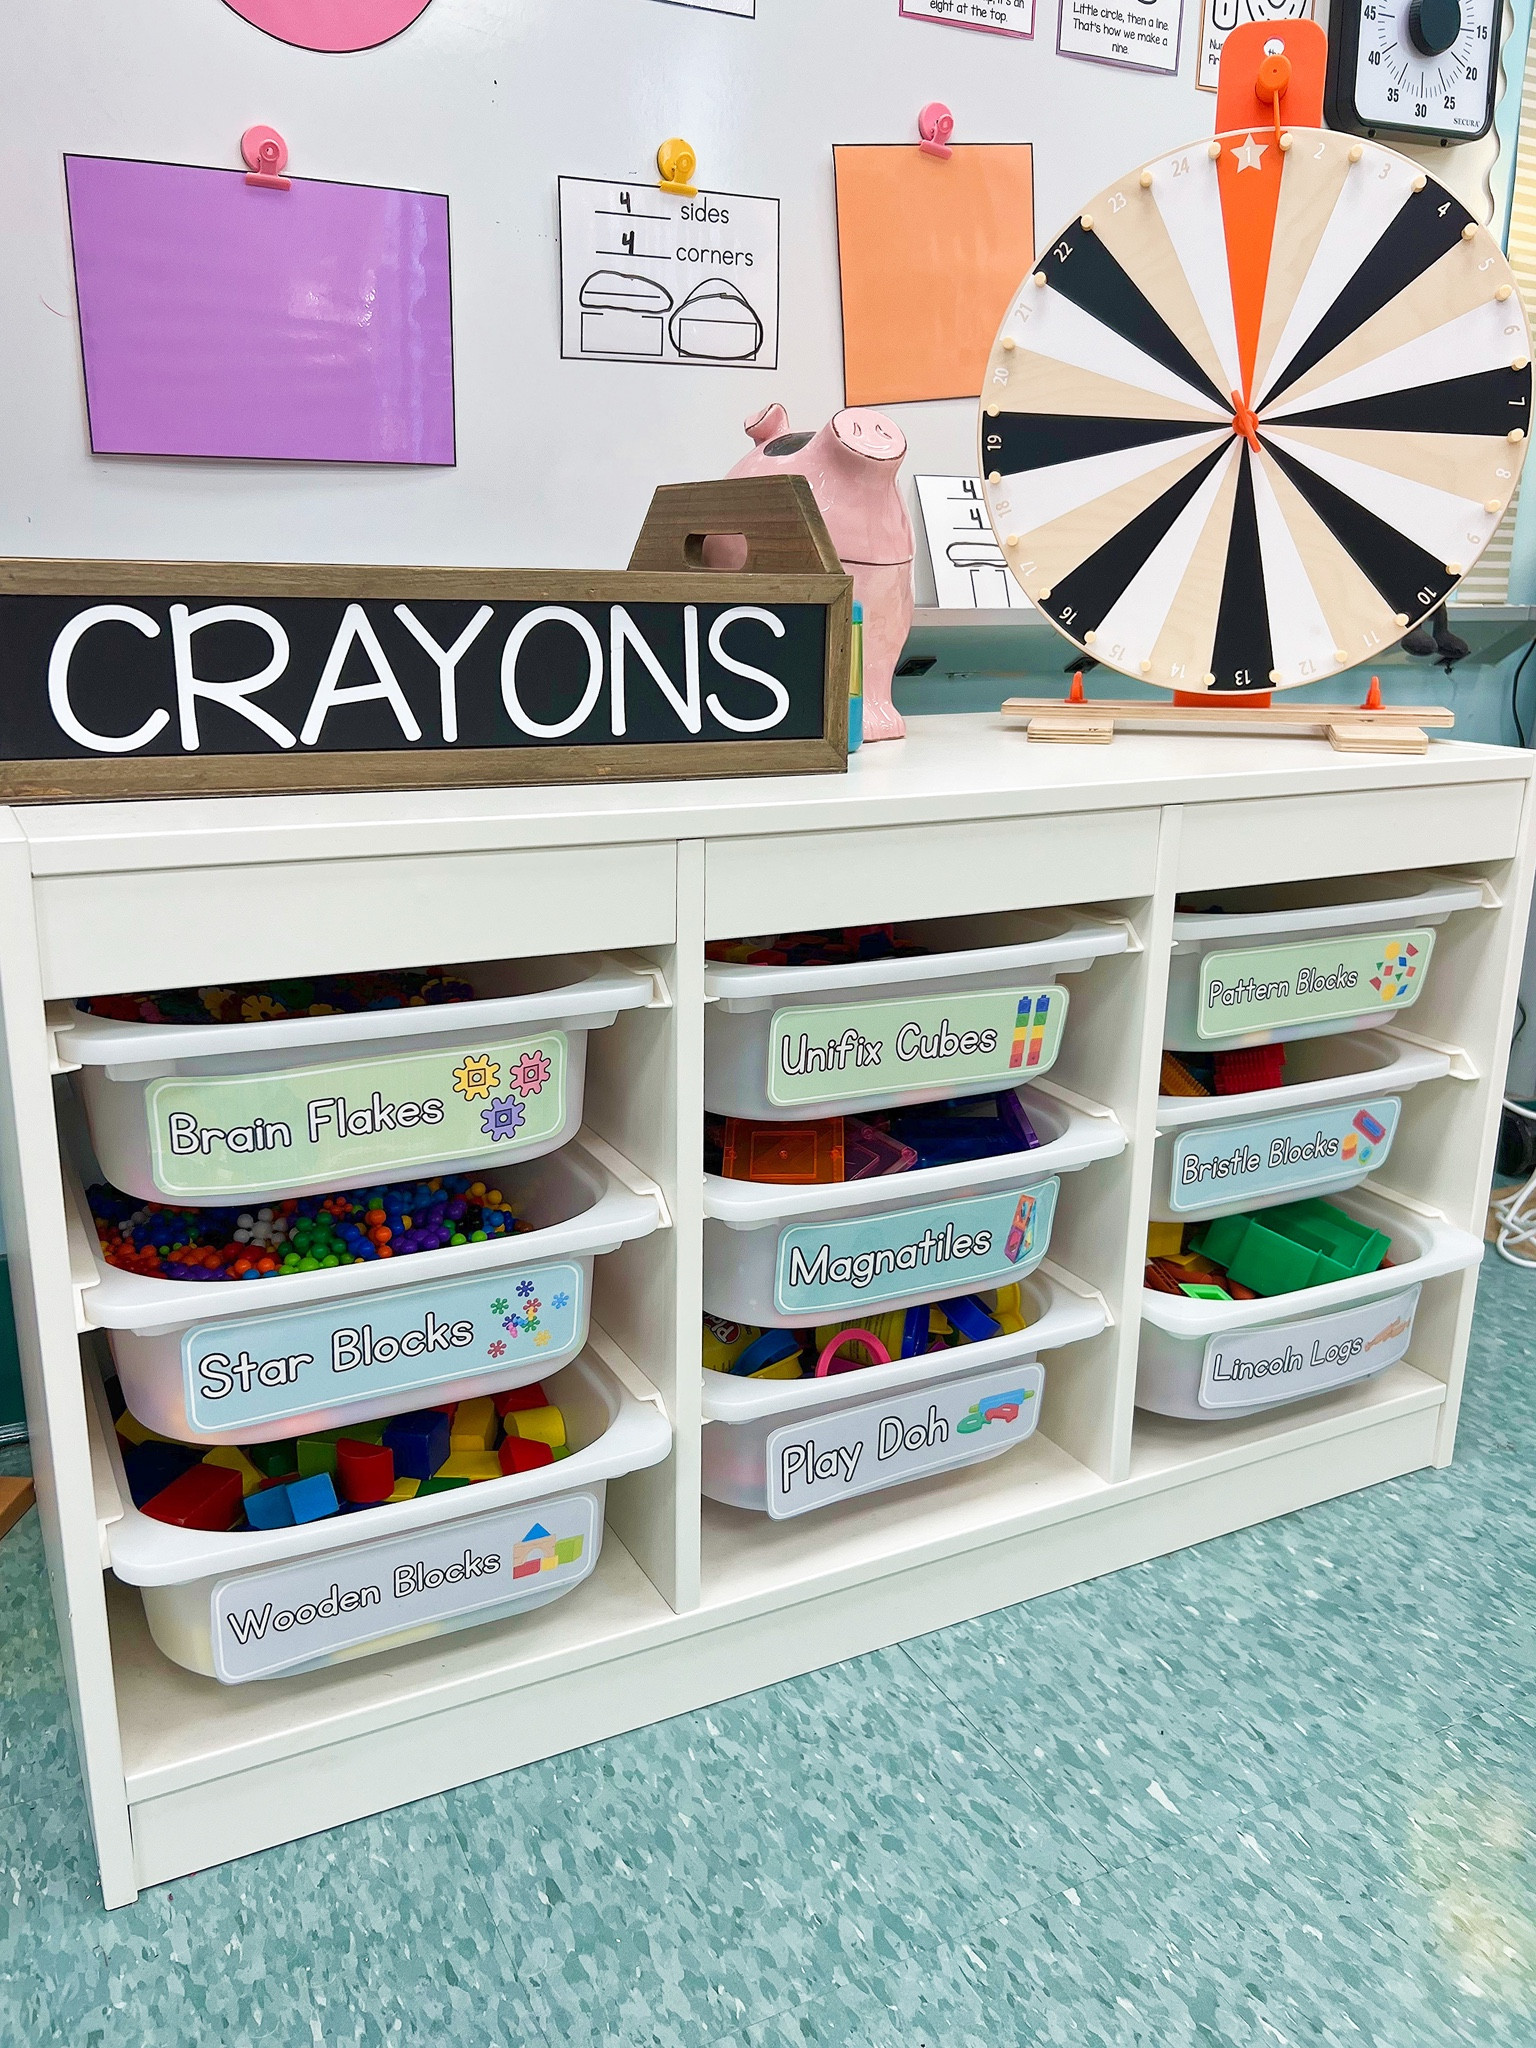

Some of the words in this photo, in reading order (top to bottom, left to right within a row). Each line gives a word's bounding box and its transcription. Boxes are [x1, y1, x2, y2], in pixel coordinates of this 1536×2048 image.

[930, 0, 954, 13] eight
[957, 3, 968, 14] at
[971, 4, 987, 18] the
[989, 8, 1008, 24] top.
[1073, 2, 1098, 16] Little
[1100, 8, 1124, 23] circle,
[1127, 12, 1147, 26] then
[1148, 19, 1154, 28] a
[1155, 18, 1170, 31] line.
[1364, 5, 1376, 20] 45
[1073, 18, 1101, 33] That's
[1103, 24, 1122, 37] how
[1124, 31, 1136, 40] we
[1137, 33, 1160, 45] make
[1162, 37, 1168, 46] a
[1477, 25, 1488, 40] 15
[1112, 42, 1130, 55] nine.
[1368, 50, 1381, 66] 40
[1466, 66, 1478, 81] 20
[1387, 87, 1399, 103] 35
[1444, 95, 1456, 110] 25
[1414, 103, 1427, 118] 30
[1453, 118, 1479, 128] SECURA
[1313, 143, 1326, 160] 2
[1171, 157, 1190, 177] 24
[1378, 162, 1391, 180] 3
[620, 191, 632, 213] 4
[680, 196, 730, 224] sides
[1107, 191, 1127, 214] 23
[1437, 201, 1452, 218] 4
[621, 230, 635, 255] 4
[676, 246, 754, 266] corners
[1053, 241, 1073, 263] 22
[1478, 257, 1495, 271] 5
[1014, 302, 1033, 323] 21
[993, 367, 1009, 386] 20
[1508, 396, 1526, 406] 7
[986, 434, 1002, 451] 19
[1495, 468, 1511, 480] 8
[962, 480, 977, 499] 4
[969, 508, 983, 529] 4
[995, 500, 1012, 518] 18
[1019, 560, 1037, 577] 17
[1417, 584, 1437, 605] 10
[1059, 605, 1079, 625] 16
[1362, 630, 1380, 647] 11
[1108, 643, 1126, 661] 15
[1170, 662, 1186, 679] 14
[1298, 658, 1317, 676] 12
[48, 603, 790, 753] CRAYONS
[1234, 669, 1251, 685] 13
[1208, 977, 1289, 1008] Pattern
[1296, 964, 1358, 996] Blocks
[781, 1028, 883, 1076] Unifix
[896, 1018, 998, 1062] Cubes
[168, 1112, 292, 1157] Brain
[307, 1092, 445, 1143] Flakes
[1181, 1145, 1260, 1185] Bristle
[1268, 1131, 1339, 1168] Blocks
[789, 1222, 993, 1287] Magnatiles
[199, 1351, 314, 1400] Star
[331, 1311, 474, 1373] Blocks
[1212, 1346, 1303, 1382] Lincoln
[1310, 1337, 1363, 1366] Logs
[781, 1440, 863, 1493] Play
[877, 1404, 950, 1462] Doh
[227, 1583, 381, 1645] Wooden
[393, 1549, 501, 1599] Blocks
